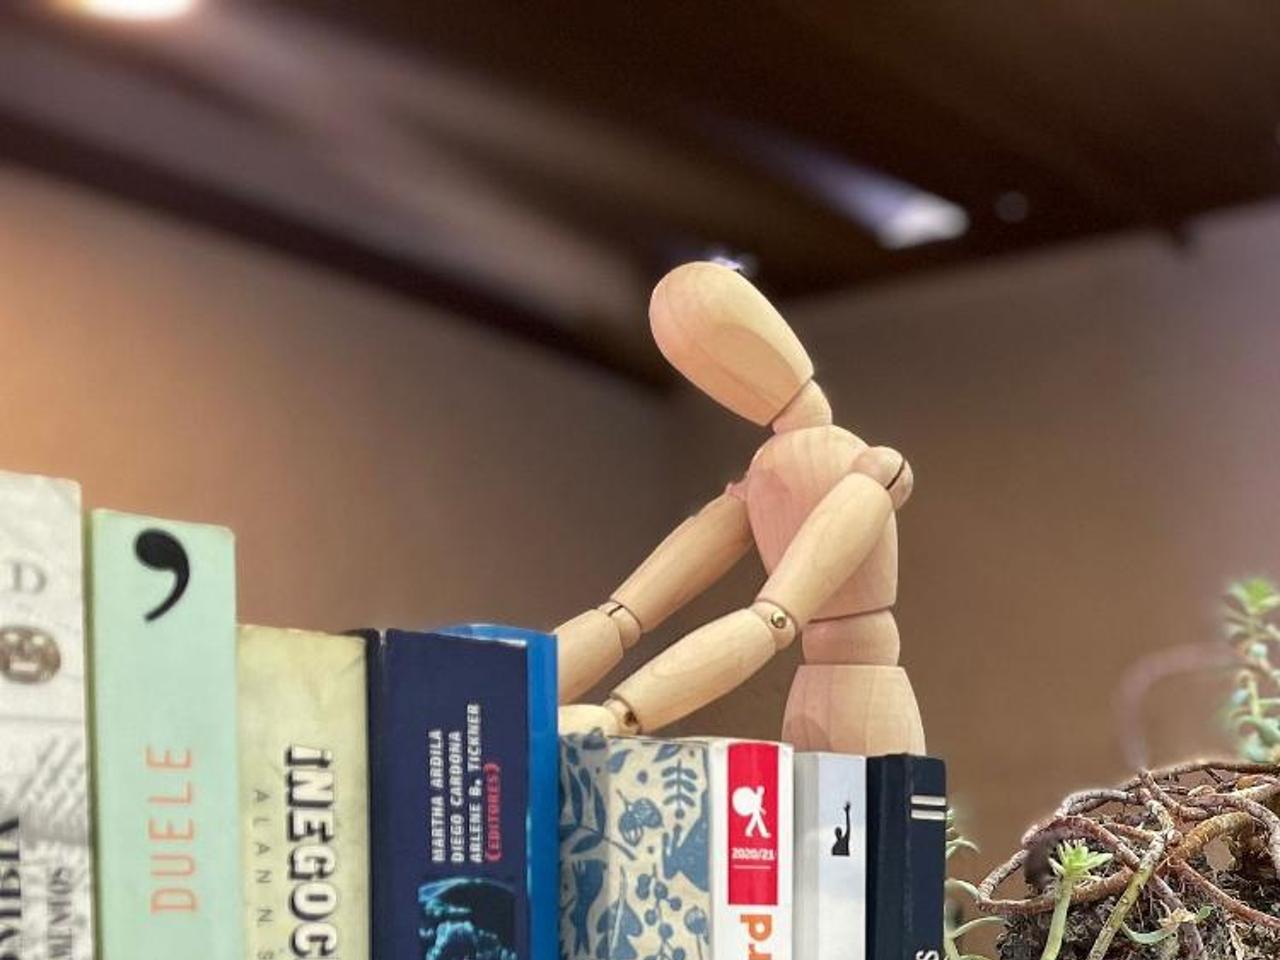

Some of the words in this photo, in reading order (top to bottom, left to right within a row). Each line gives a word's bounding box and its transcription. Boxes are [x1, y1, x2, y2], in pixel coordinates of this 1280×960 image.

[428, 730, 445, 789] ARDILA
[447, 731, 464, 806] CARDONA
[466, 704, 482, 773] TICKNER
[468, 778, 483, 796] B.
[482, 763, 503, 863] (EDITORES)
[146, 744, 198, 915] DUELE
[253, 789, 274, 886] ALAN
[431, 796, 446, 863] MARTHA
[450, 814, 466, 863] DIEGO
[468, 803, 483, 863] ARLENE
